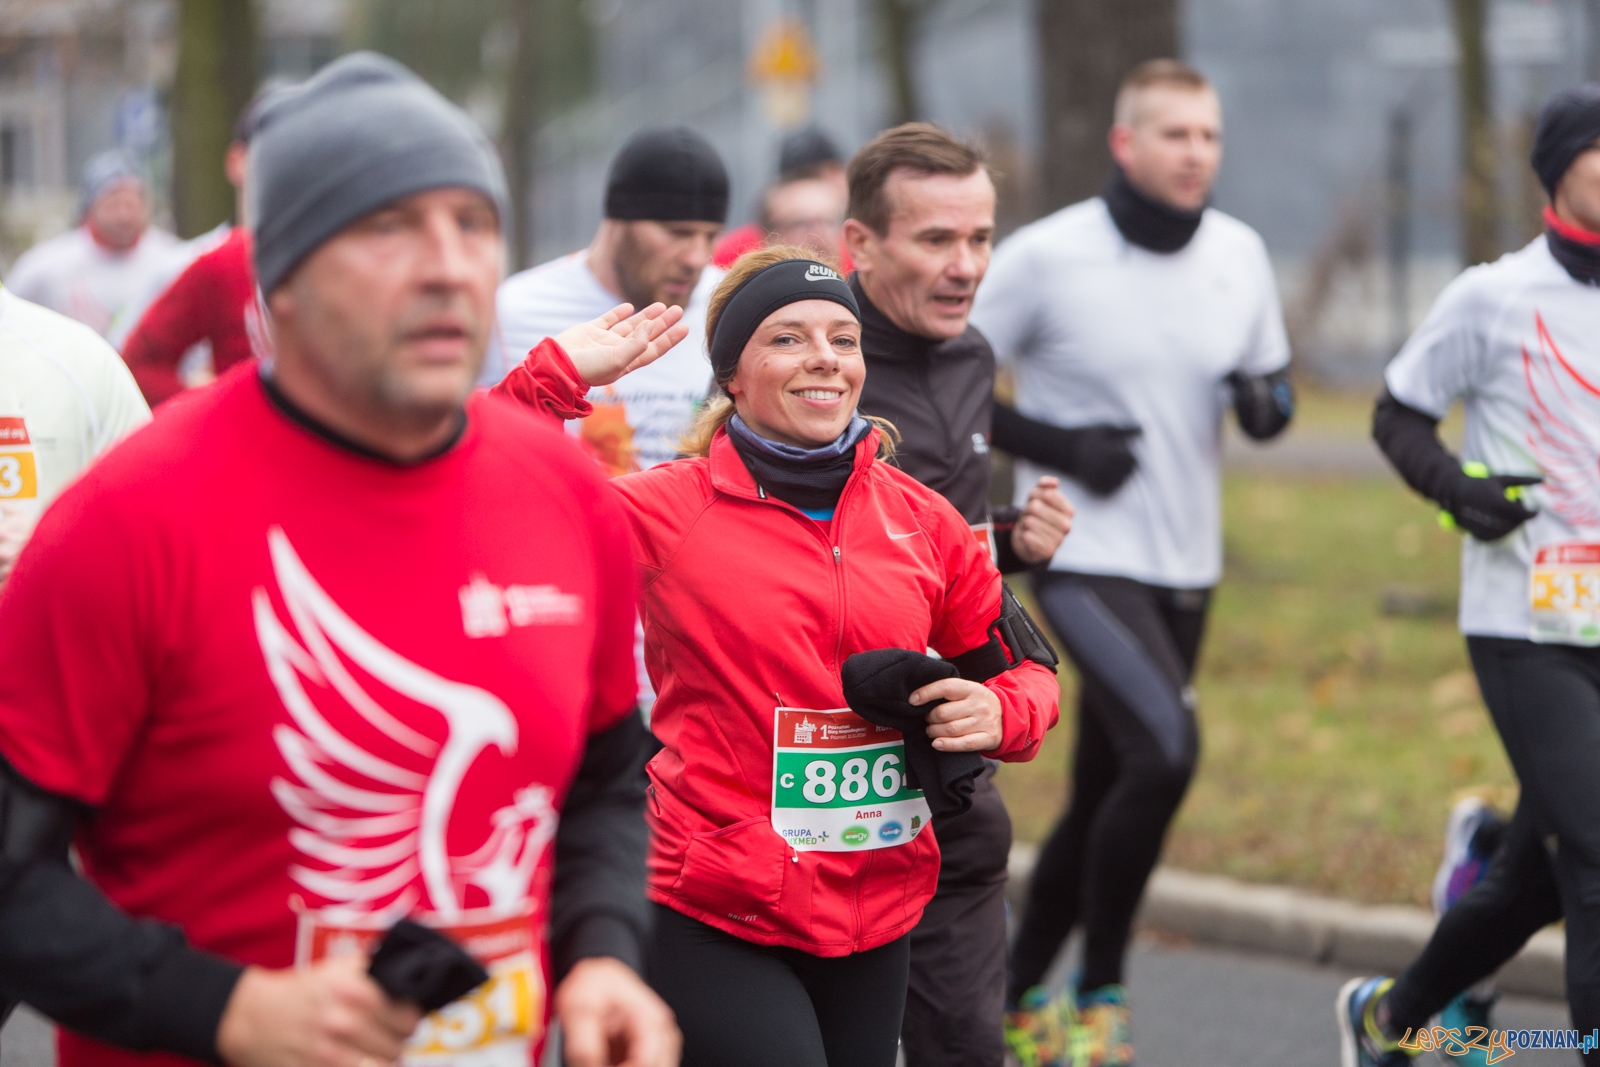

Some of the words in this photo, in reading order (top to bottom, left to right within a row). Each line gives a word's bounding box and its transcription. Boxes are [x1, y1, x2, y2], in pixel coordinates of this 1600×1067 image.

[809, 264, 838, 279] RUN
[820, 724, 829, 740] 1
[802, 753, 923, 804] 886
[855, 810, 883, 820] Anna
[782, 829, 812, 838] GRUPA
[727, 912, 758, 922] DRI-FIT
